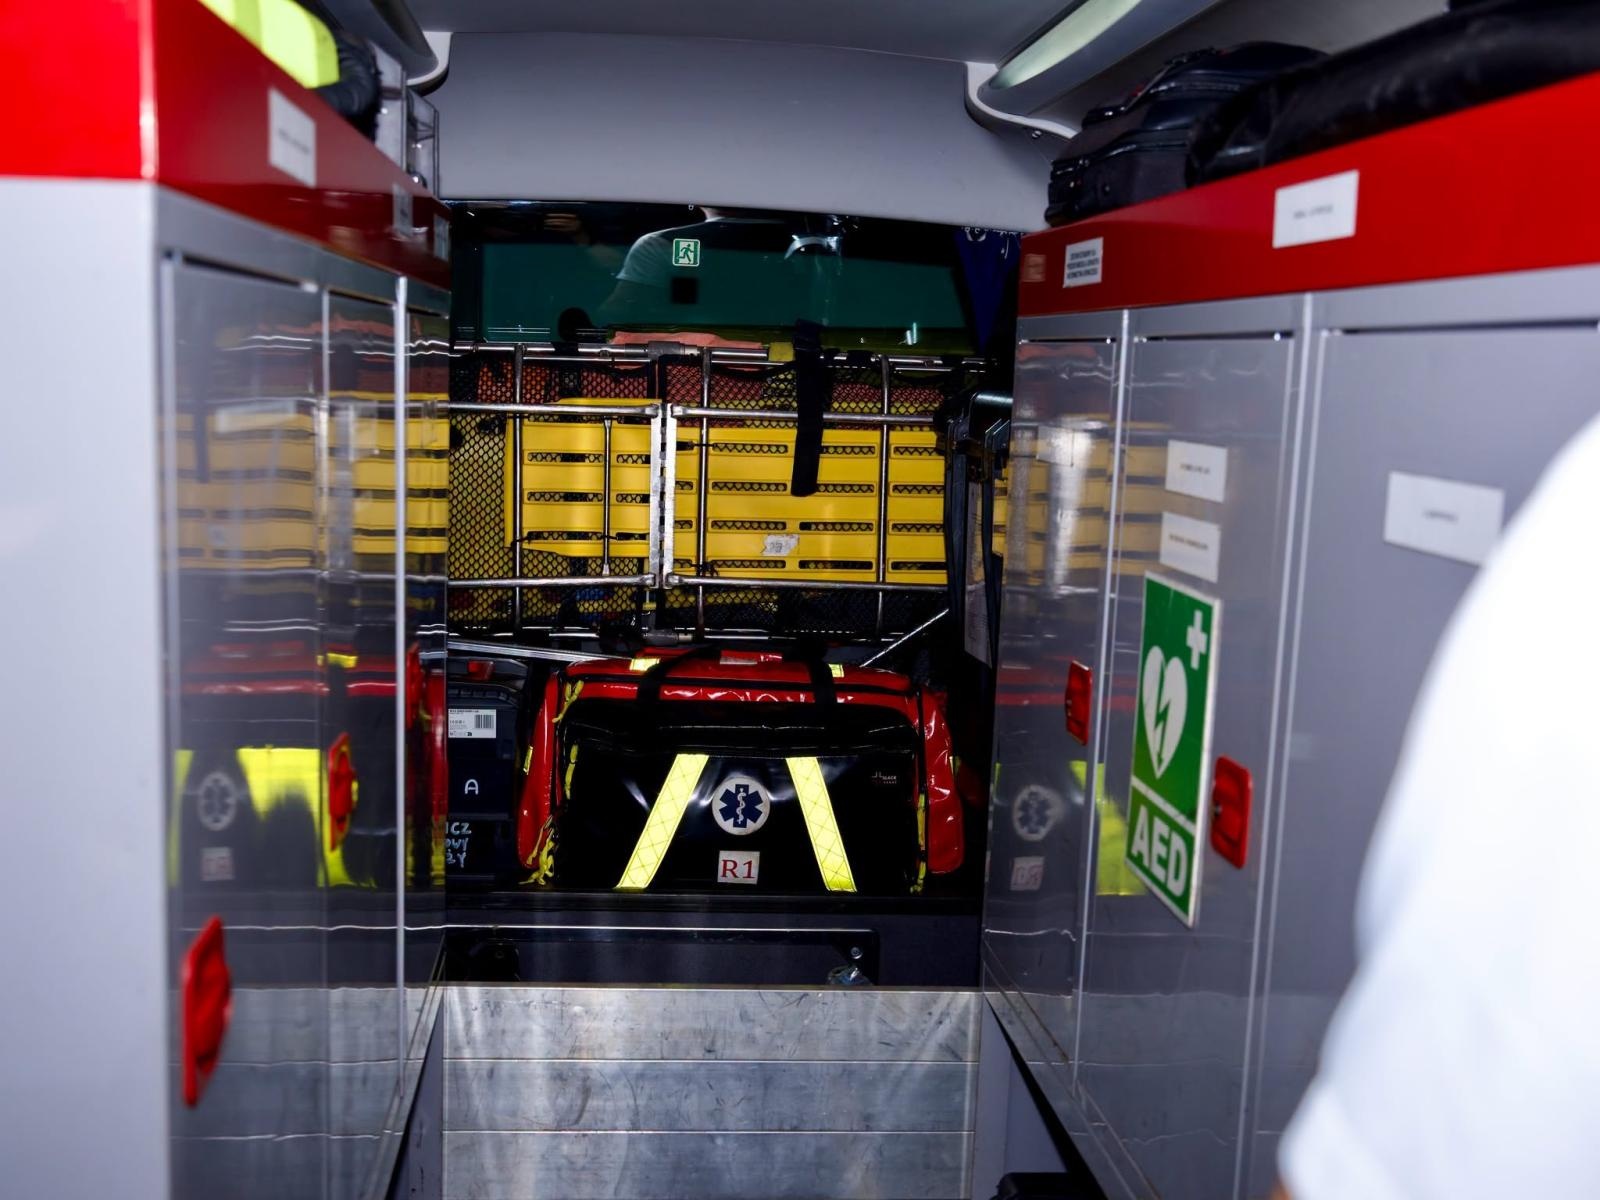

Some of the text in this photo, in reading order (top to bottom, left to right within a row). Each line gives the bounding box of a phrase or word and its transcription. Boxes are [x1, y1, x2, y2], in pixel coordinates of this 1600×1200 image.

[464, 779, 479, 795] A
[1131, 804, 1189, 898] AED
[720, 859, 757, 879] R1
